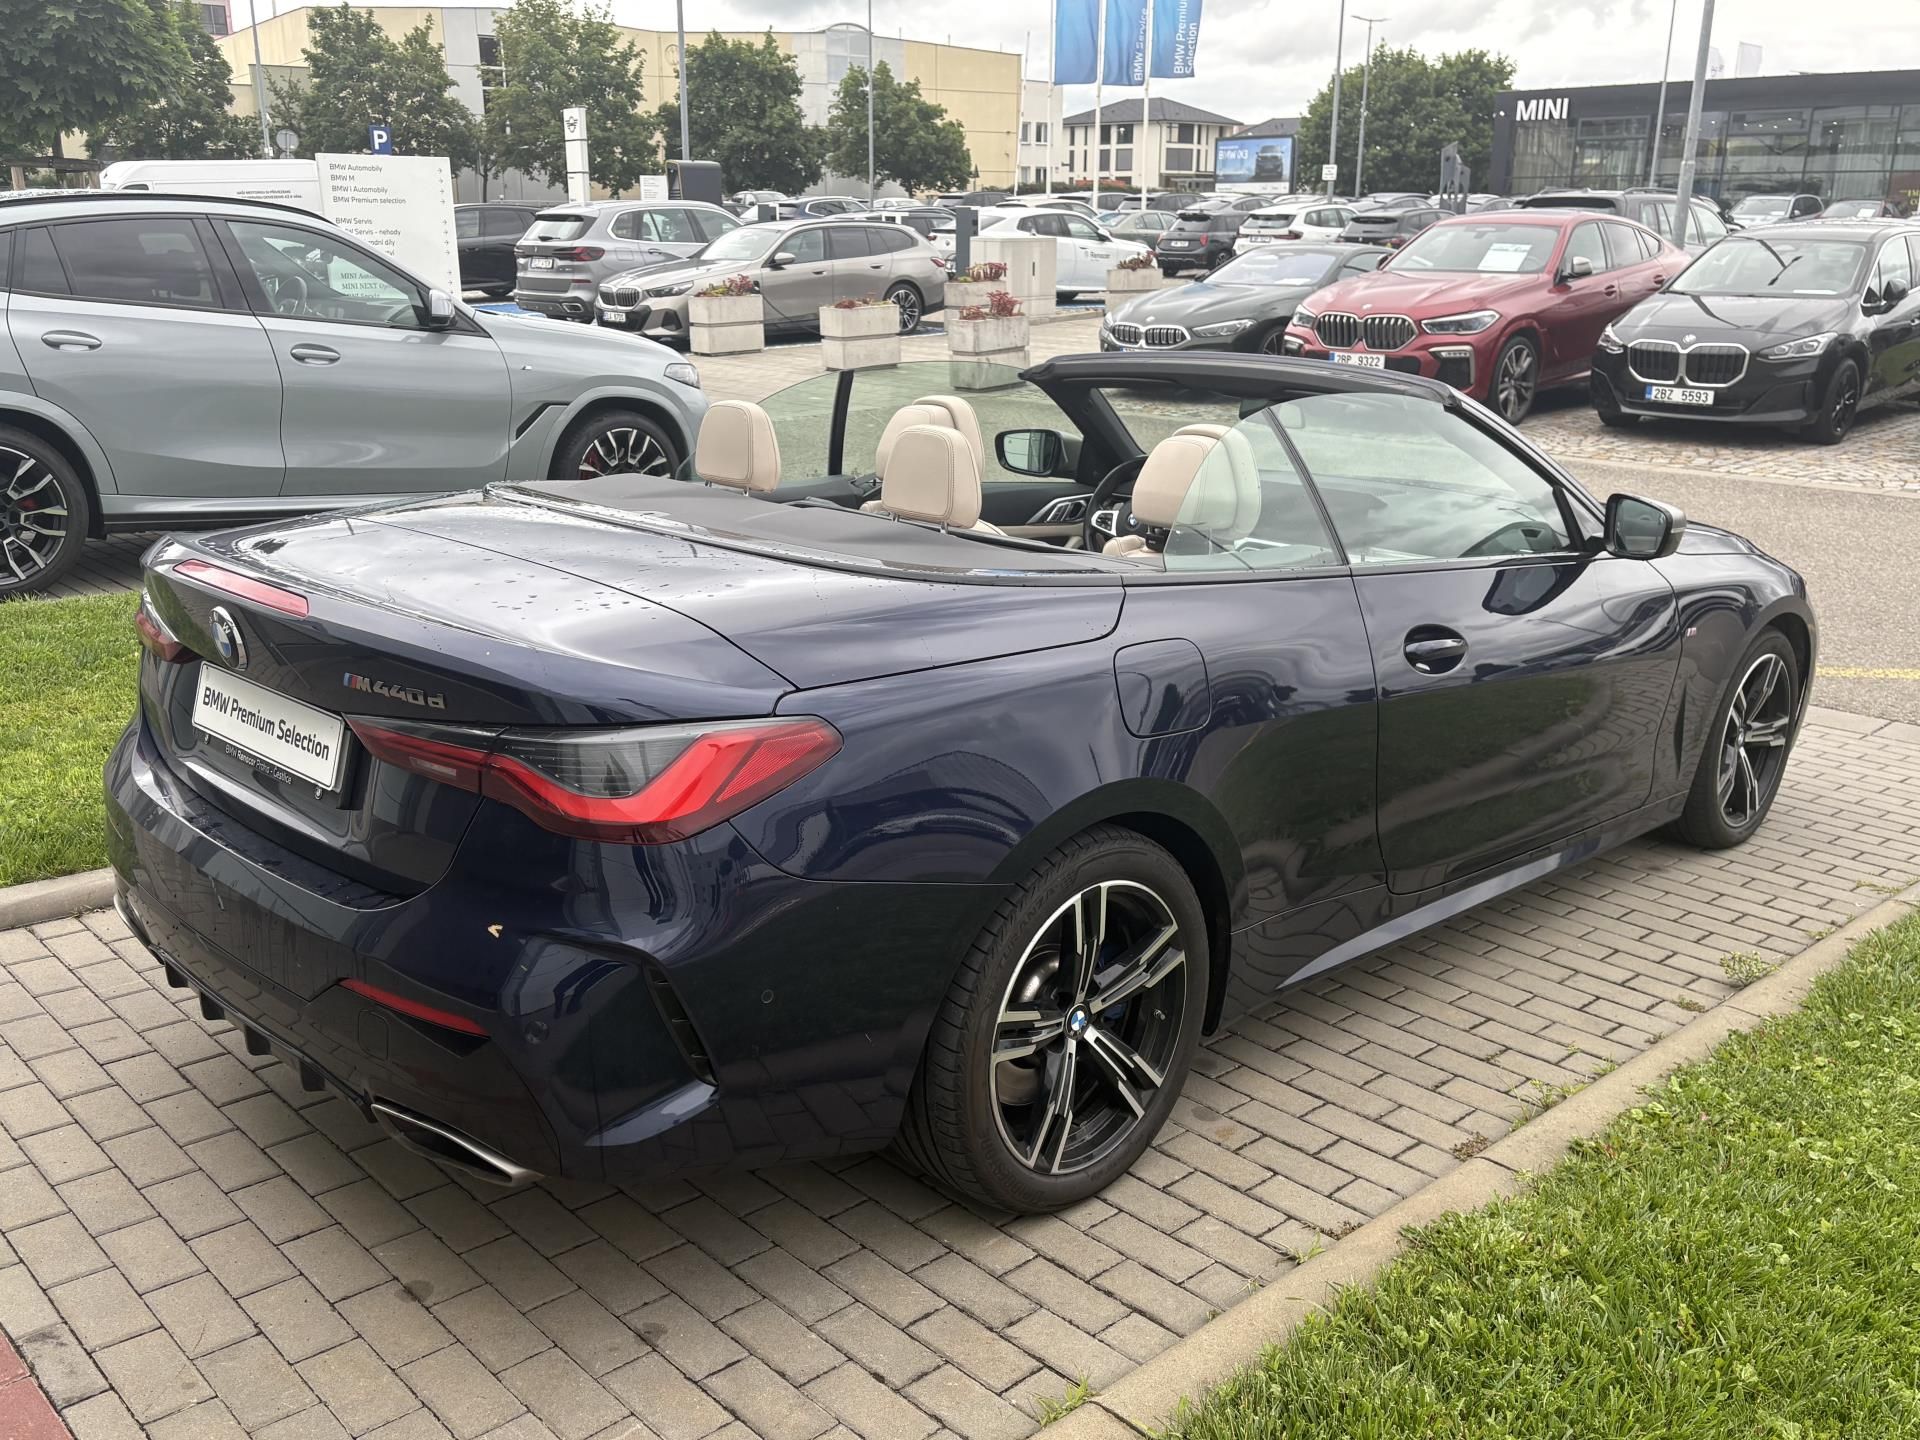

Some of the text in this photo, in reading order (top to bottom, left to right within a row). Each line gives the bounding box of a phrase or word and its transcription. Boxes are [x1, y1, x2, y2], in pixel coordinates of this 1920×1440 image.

[1134, 7, 1147, 81] BMW Service
[1173, 0, 1188, 74] BMW Premiu
[1184, 22, 1197, 74] Selection
[1515, 97, 1569, 121] MINI
[373, 130, 387, 150] P
[329, 163, 383, 173] BMW Automobily
[353, 186, 388, 194] Automobily
[351, 196, 379, 204] Premium
[353, 217, 373, 225] Servis
[354, 228, 374, 236] Servis
[378, 228, 401, 236] nehody
[342, 282, 358, 290] MINI
[1358, 355, 1380, 367] 9322
[1654, 388, 1709, 403] 2BZ 5593
[202, 686, 330, 761] BMW Premium Selection
[225, 744, 238, 757] BMW
[237, 750, 256, 767] Renocar
